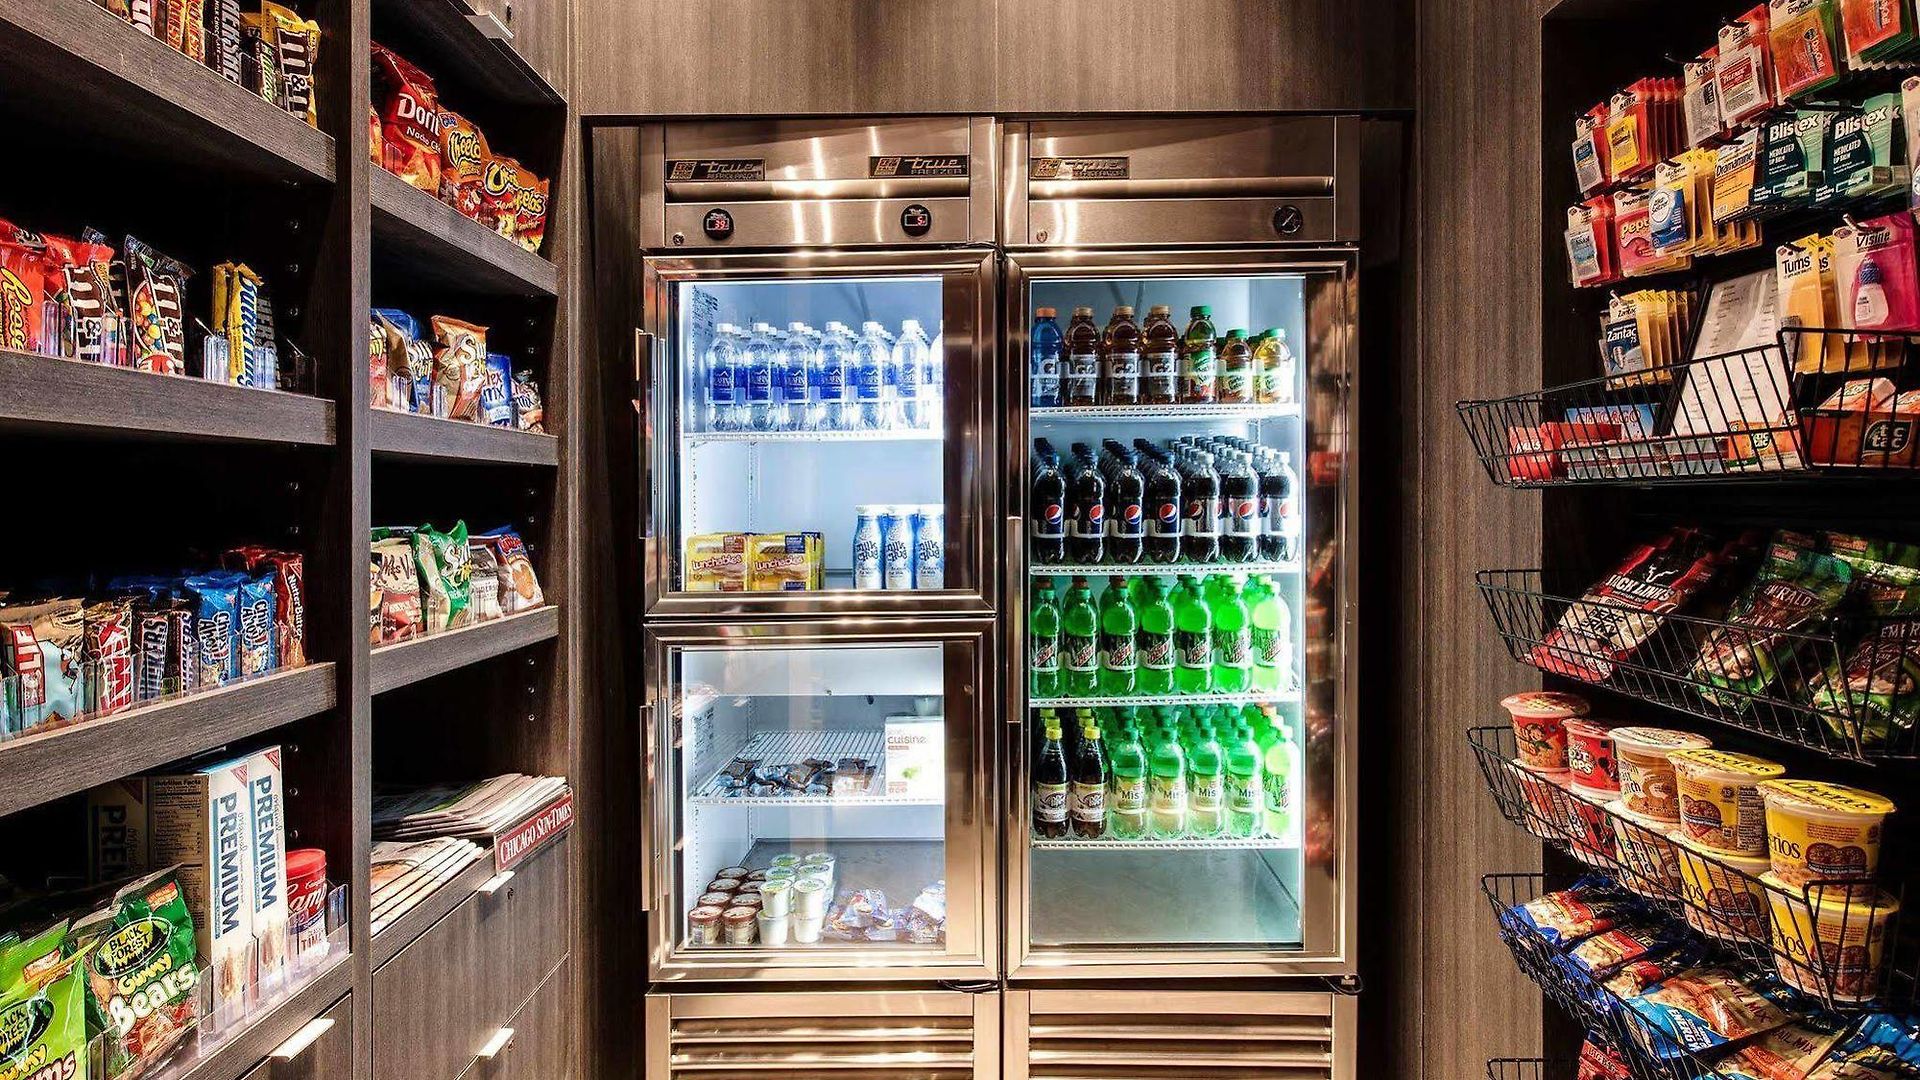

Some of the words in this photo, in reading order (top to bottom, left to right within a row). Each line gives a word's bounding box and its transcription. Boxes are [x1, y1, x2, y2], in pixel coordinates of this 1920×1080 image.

[220, 0, 241, 86] HERSHE
[1769, 113, 1819, 143] Blistex
[1834, 106, 1888, 140] Blistex
[406, 126, 430, 146] Nacho
[904, 157, 962, 169] true
[1715, 149, 1753, 177] Dramamine
[1856, 231, 1891, 248] Visine
[1781, 255, 1811, 275] Tums
[1617, 306, 1636, 319] Zantac
[1606, 326, 1637, 343] Zantac
[1630, 336, 1638, 344] 75
[1112, 363, 1135, 377] G2
[1879, 424, 1906, 438] tc
[856, 540, 877, 552] milk
[887, 540, 906, 552] milk
[919, 540, 938, 552] milk
[691, 553, 743, 571] Lunchables
[755, 555, 804, 571] Lunchables
[1606, 574, 1635, 597] JACK
[252, 599, 270, 638] Chips
[214, 610, 230, 652] Chips
[886, 735, 927, 745] cuisine
[1686, 749, 1776, 774] Cheerios
[256, 775, 278, 910] PREMIUM
[499, 825, 536, 864] CHICAGO
[537, 801, 573, 840] SUN-TIMES
[219, 791, 243, 935] PREMIUM
[108, 924, 145, 951] BLACK
[110, 933, 151, 962] FOREST
[117, 951, 173, 996] Gummy
[108, 962, 197, 1038] Bears
[1724, 979, 1753, 1003] RAIL
[1744, 1001, 1774, 1023] MIX
[1672, 1008, 1703, 1052] ENERGY
[1792, 1036, 1818, 1055] MIX
